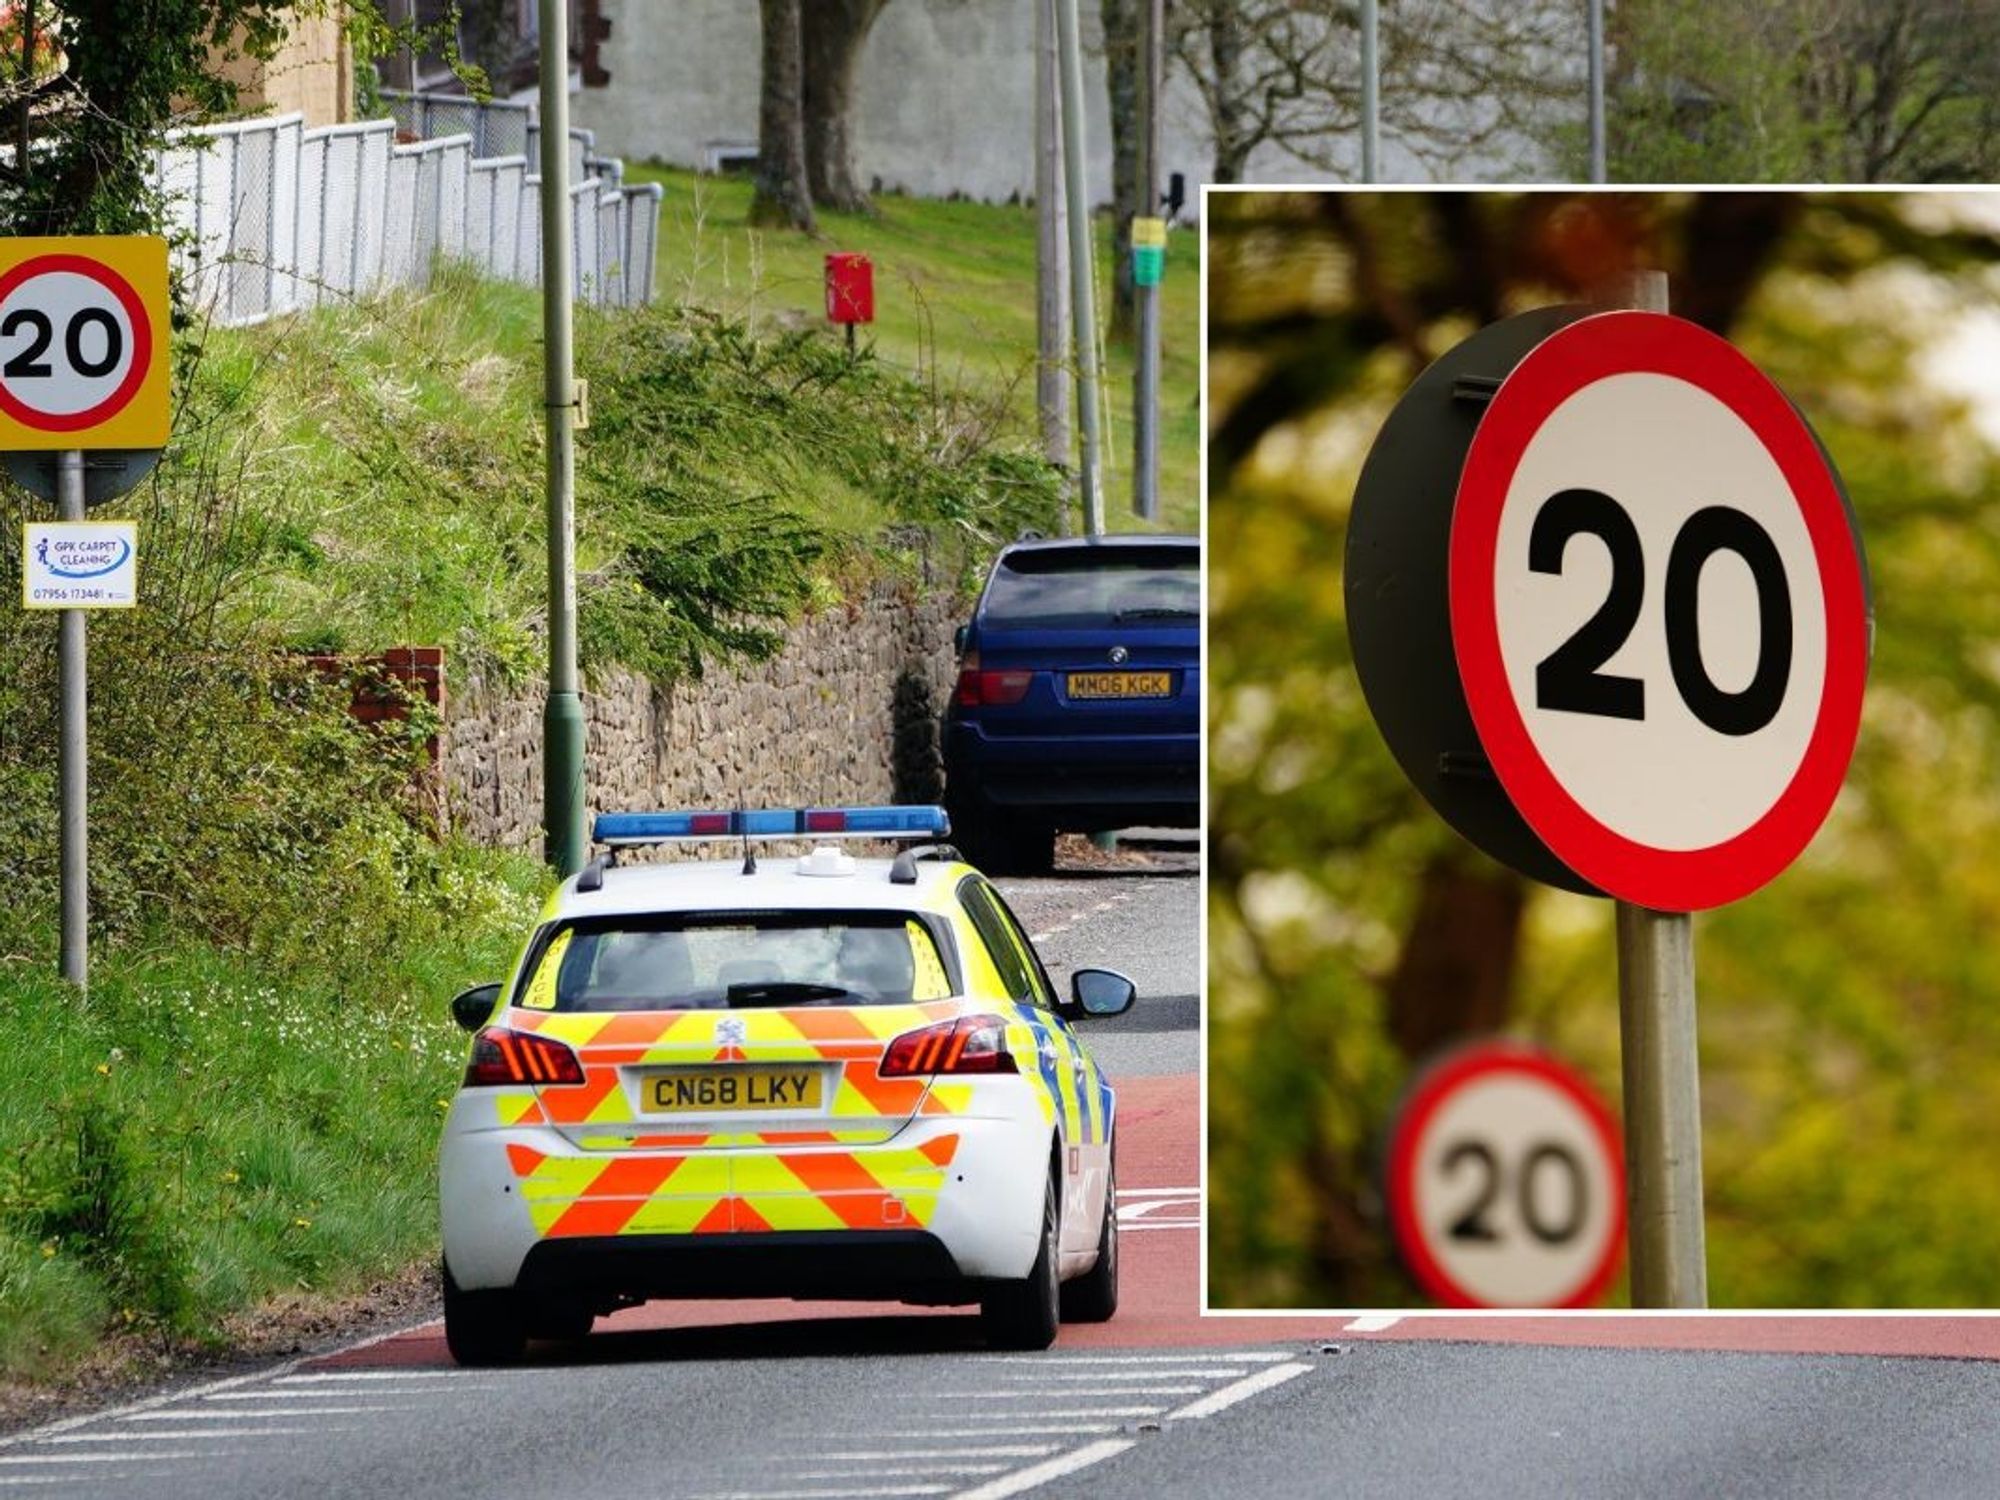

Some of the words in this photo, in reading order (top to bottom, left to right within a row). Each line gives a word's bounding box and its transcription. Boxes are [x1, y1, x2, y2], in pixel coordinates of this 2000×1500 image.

[1, 307, 122, 377] 20
[59, 554, 112, 565] CLEANING
[78, 541, 116, 552] CARPET
[1528, 488, 1793, 737] 20
[1127, 676, 1165, 694] KGK
[655, 1077, 738, 1107] CN68
[747, 1074, 809, 1104] LKY
[1438, 1138, 1590, 1249] 20
